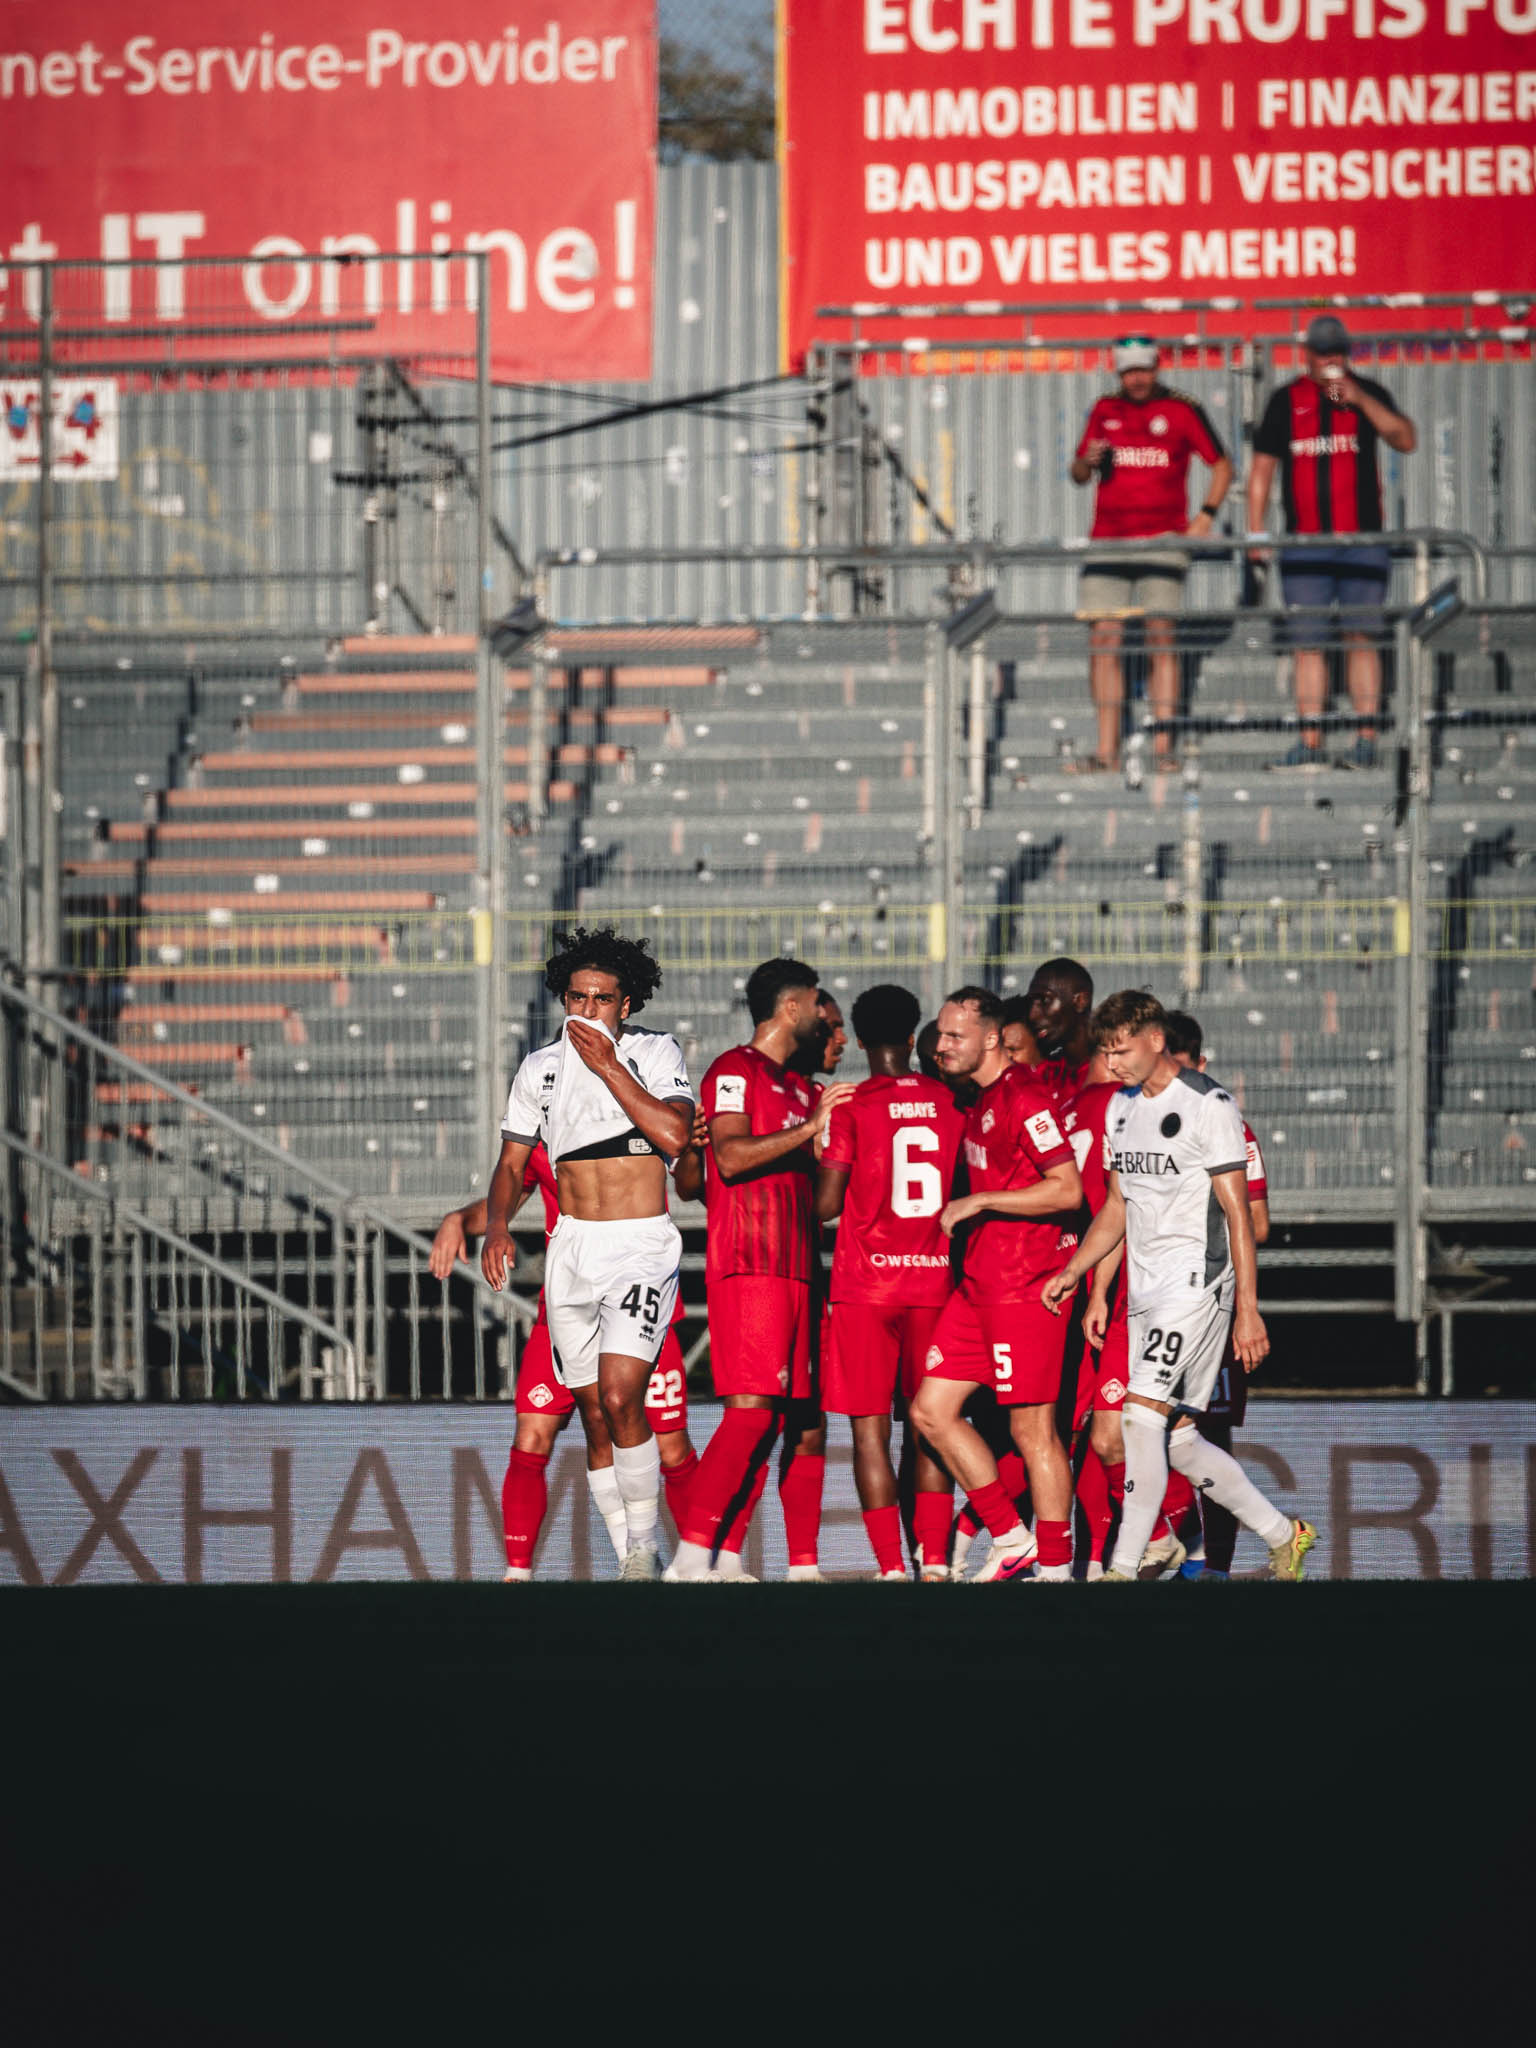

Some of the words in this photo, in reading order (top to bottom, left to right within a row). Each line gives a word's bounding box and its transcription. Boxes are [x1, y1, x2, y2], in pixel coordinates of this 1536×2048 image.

[864, 0, 1115, 54] ECHTE
[0, 20, 628, 98] net-Service-Provider
[864, 82, 1198, 140] IMMOBILIEN
[1258, 71, 1536, 128] FINANZIER
[865, 155, 1186, 214] BAUSPAREN
[1234, 144, 1536, 202] VERSICHER
[102, 211, 205, 322] IT
[242, 199, 637, 319] online!
[866, 237, 982, 288] UND
[990, 231, 1171, 284] VIELES
[1181, 227, 1356, 280] MEHR!
[888, 1102, 938, 1119] EMBAYE
[891, 1126, 943, 1219] 6
[1124, 1151, 1181, 1175] BRITA
[619, 1284, 661, 1325] 45
[993, 1342, 1013, 1380] 5
[1142, 1328, 1183, 1367] 29
[644, 1369, 684, 1408] 22
